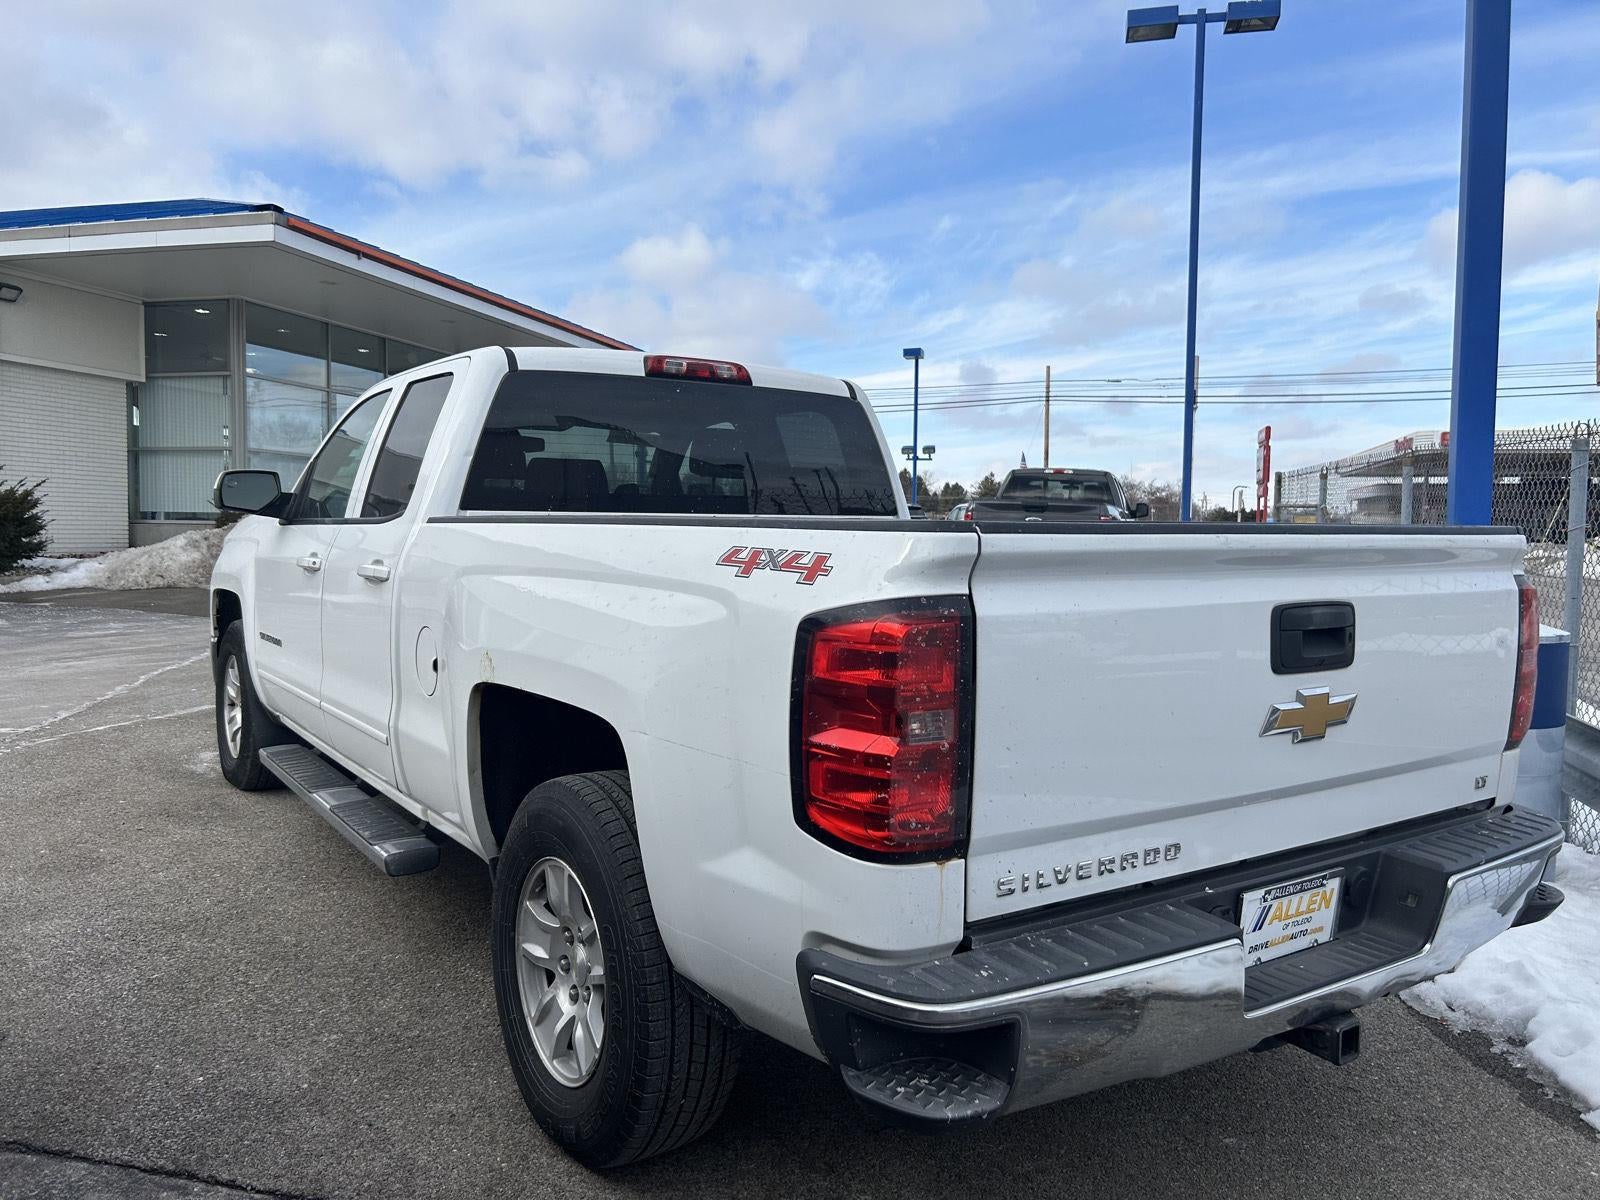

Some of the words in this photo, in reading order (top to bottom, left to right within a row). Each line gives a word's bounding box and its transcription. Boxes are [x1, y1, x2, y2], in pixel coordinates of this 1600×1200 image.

[996, 842, 1181, 898] SILVERADO
[1275, 884, 1295, 898] ALLEN
[1294, 882, 1303, 893] OF
[1302, 878, 1322, 890] TOLEDO
[1268, 888, 1334, 925] ALLEN
[1282, 921, 1291, 931] OF
[1291, 916, 1312, 928] TOLEDO
